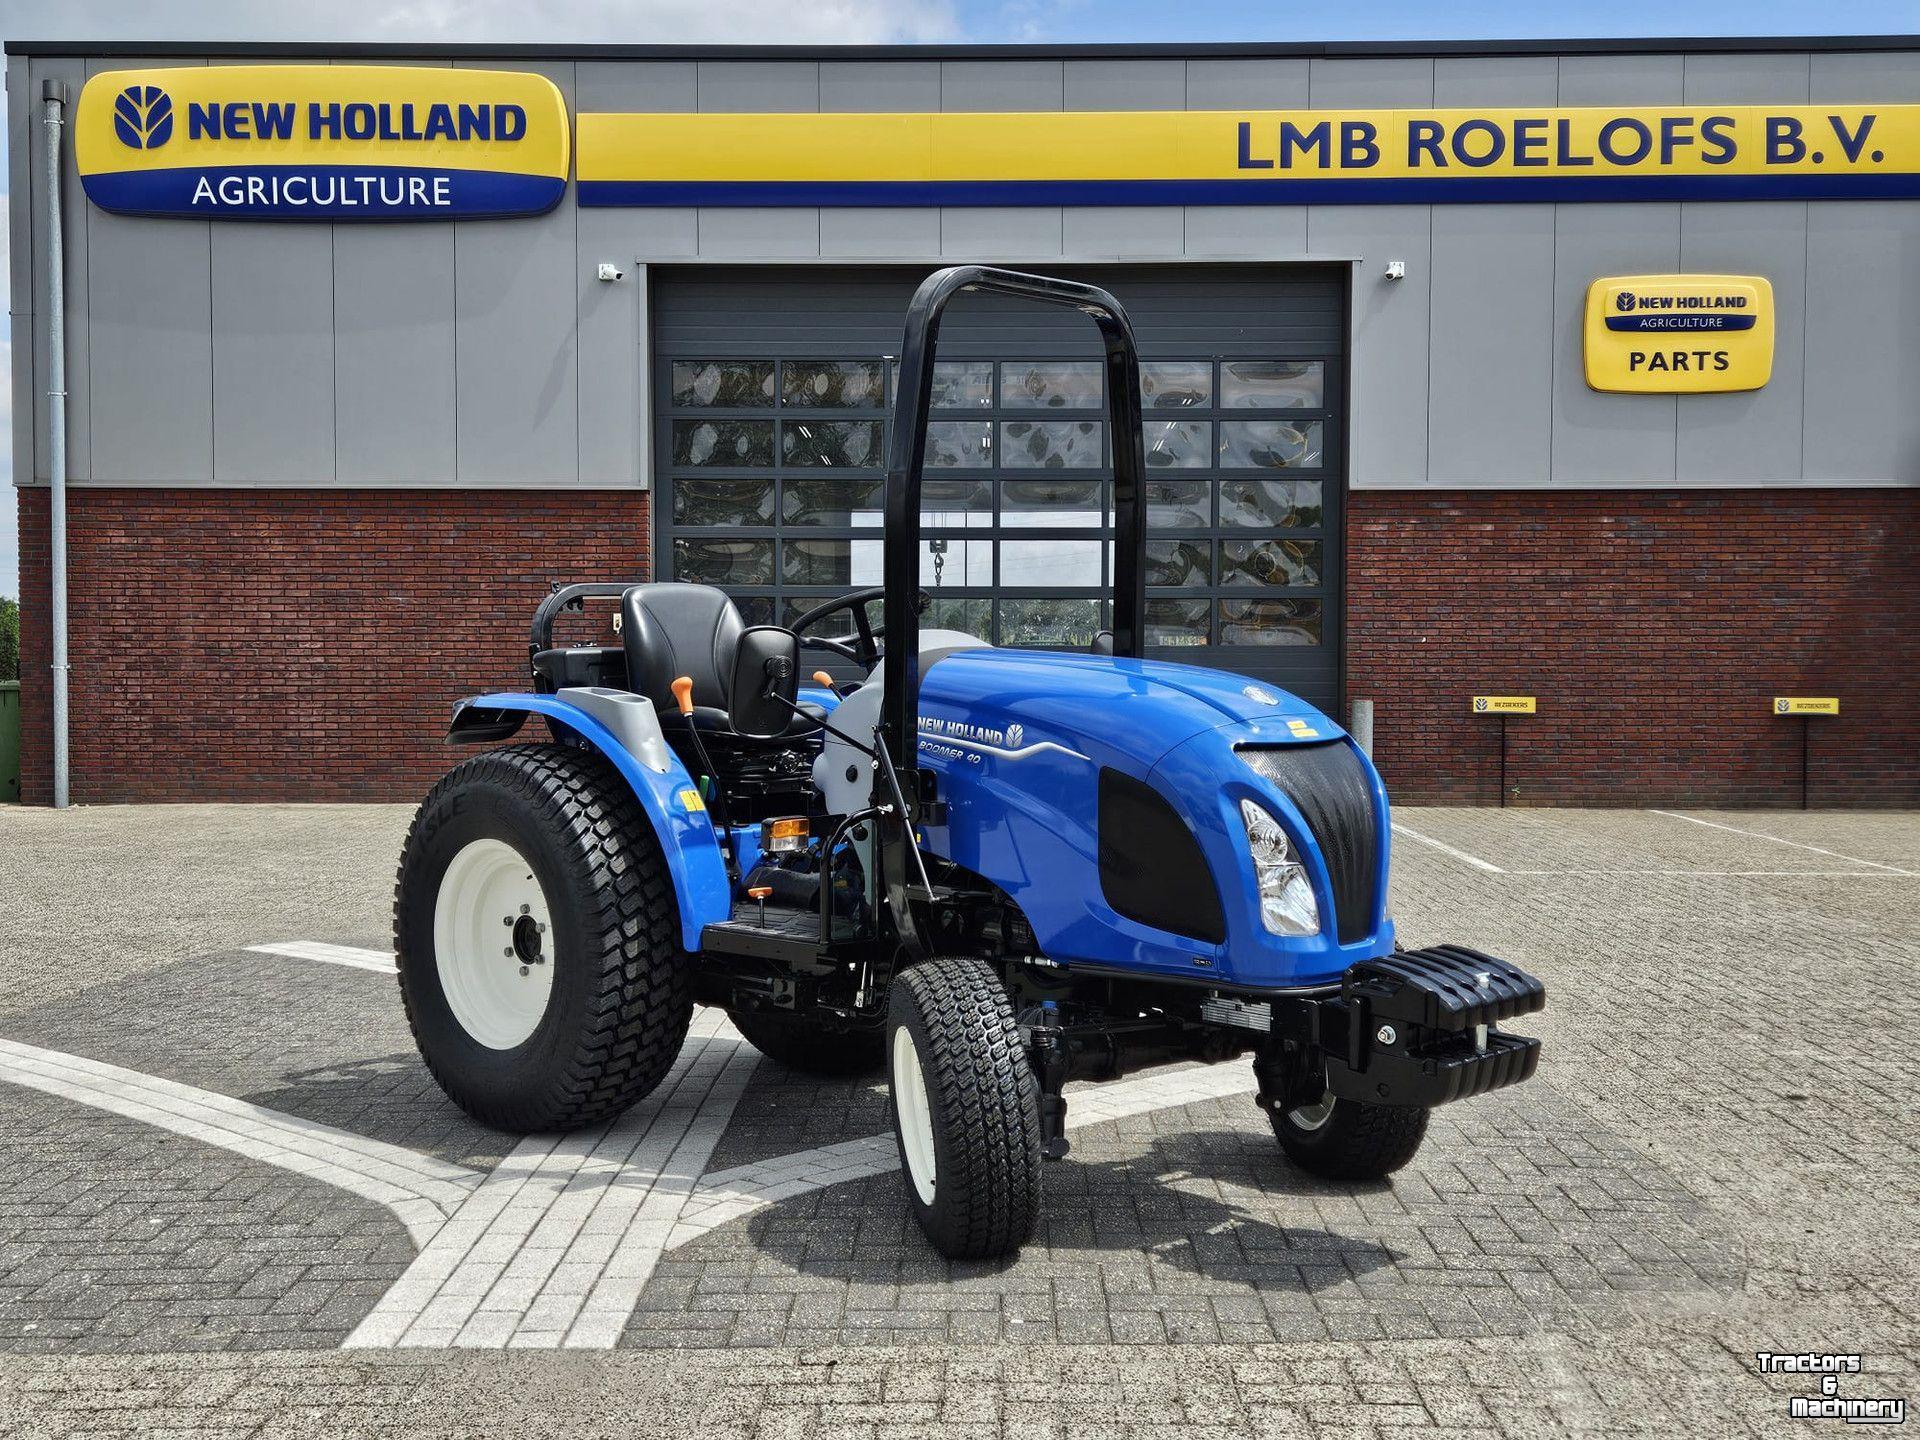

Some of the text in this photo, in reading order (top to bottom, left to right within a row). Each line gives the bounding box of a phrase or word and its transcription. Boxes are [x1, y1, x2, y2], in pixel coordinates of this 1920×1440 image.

[188, 102, 527, 142] NEW HOLLAND
[1236, 114, 1885, 169] LMB ROELOFS B.V.
[192, 175, 451, 206] AGRICULTURE
[1638, 296, 1748, 309] NEW HOLLAND
[1639, 317, 1723, 328] AGRICULTURE
[1629, 351, 1730, 372] PARTS
[918, 717, 1003, 745] NEW HOLLAND
[919, 741, 981, 764] BOOMER 40
